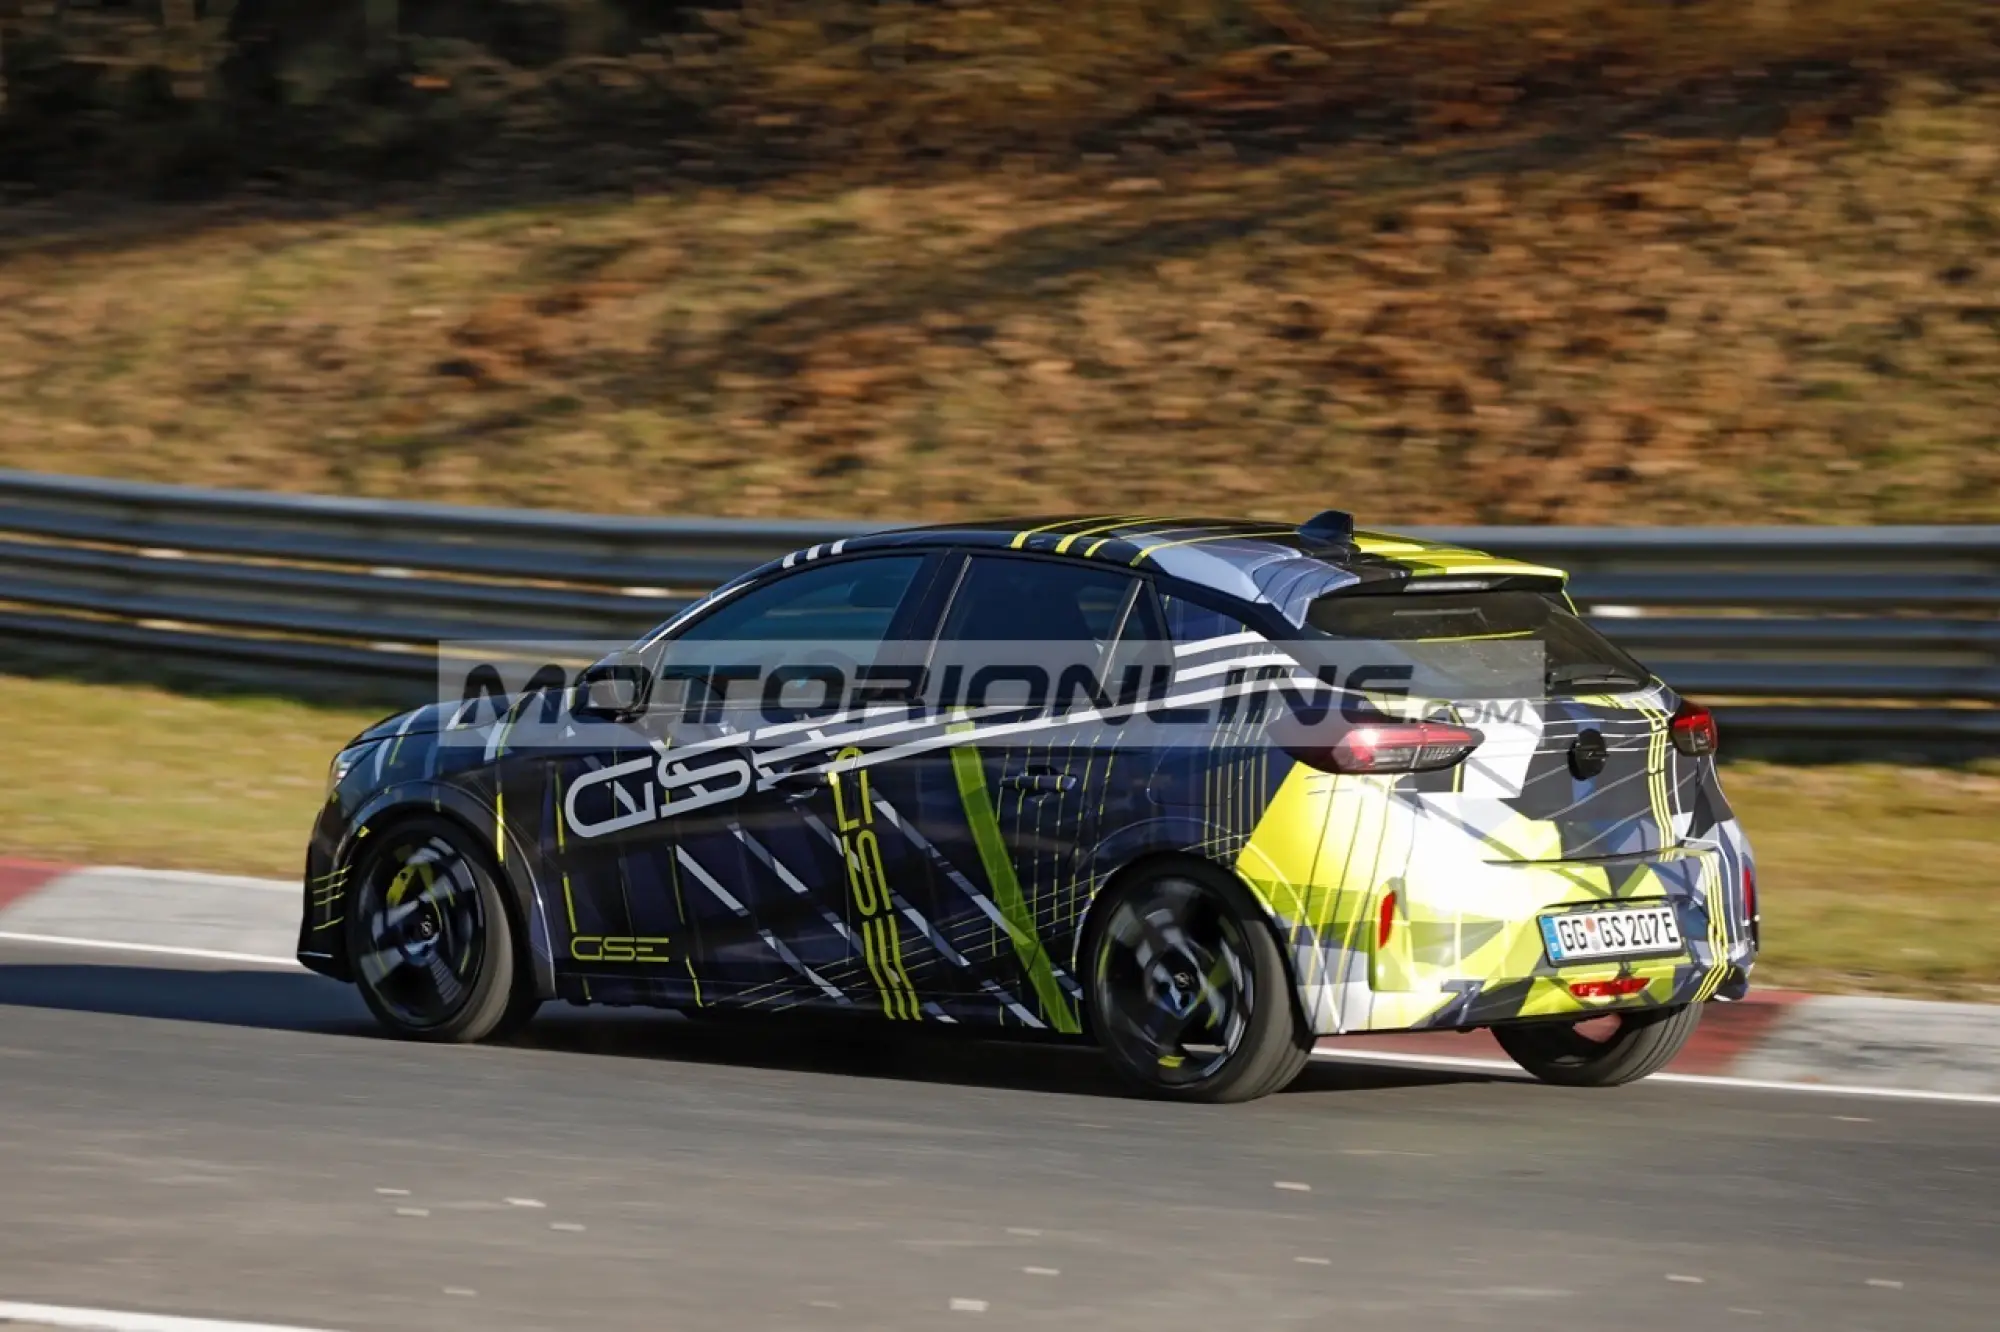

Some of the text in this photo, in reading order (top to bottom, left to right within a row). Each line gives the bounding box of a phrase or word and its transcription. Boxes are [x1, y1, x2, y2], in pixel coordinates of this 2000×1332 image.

[827, 746, 922, 1021] GSE
[570, 936, 670, 963] GSE
[1558, 919, 1588, 950] GG
